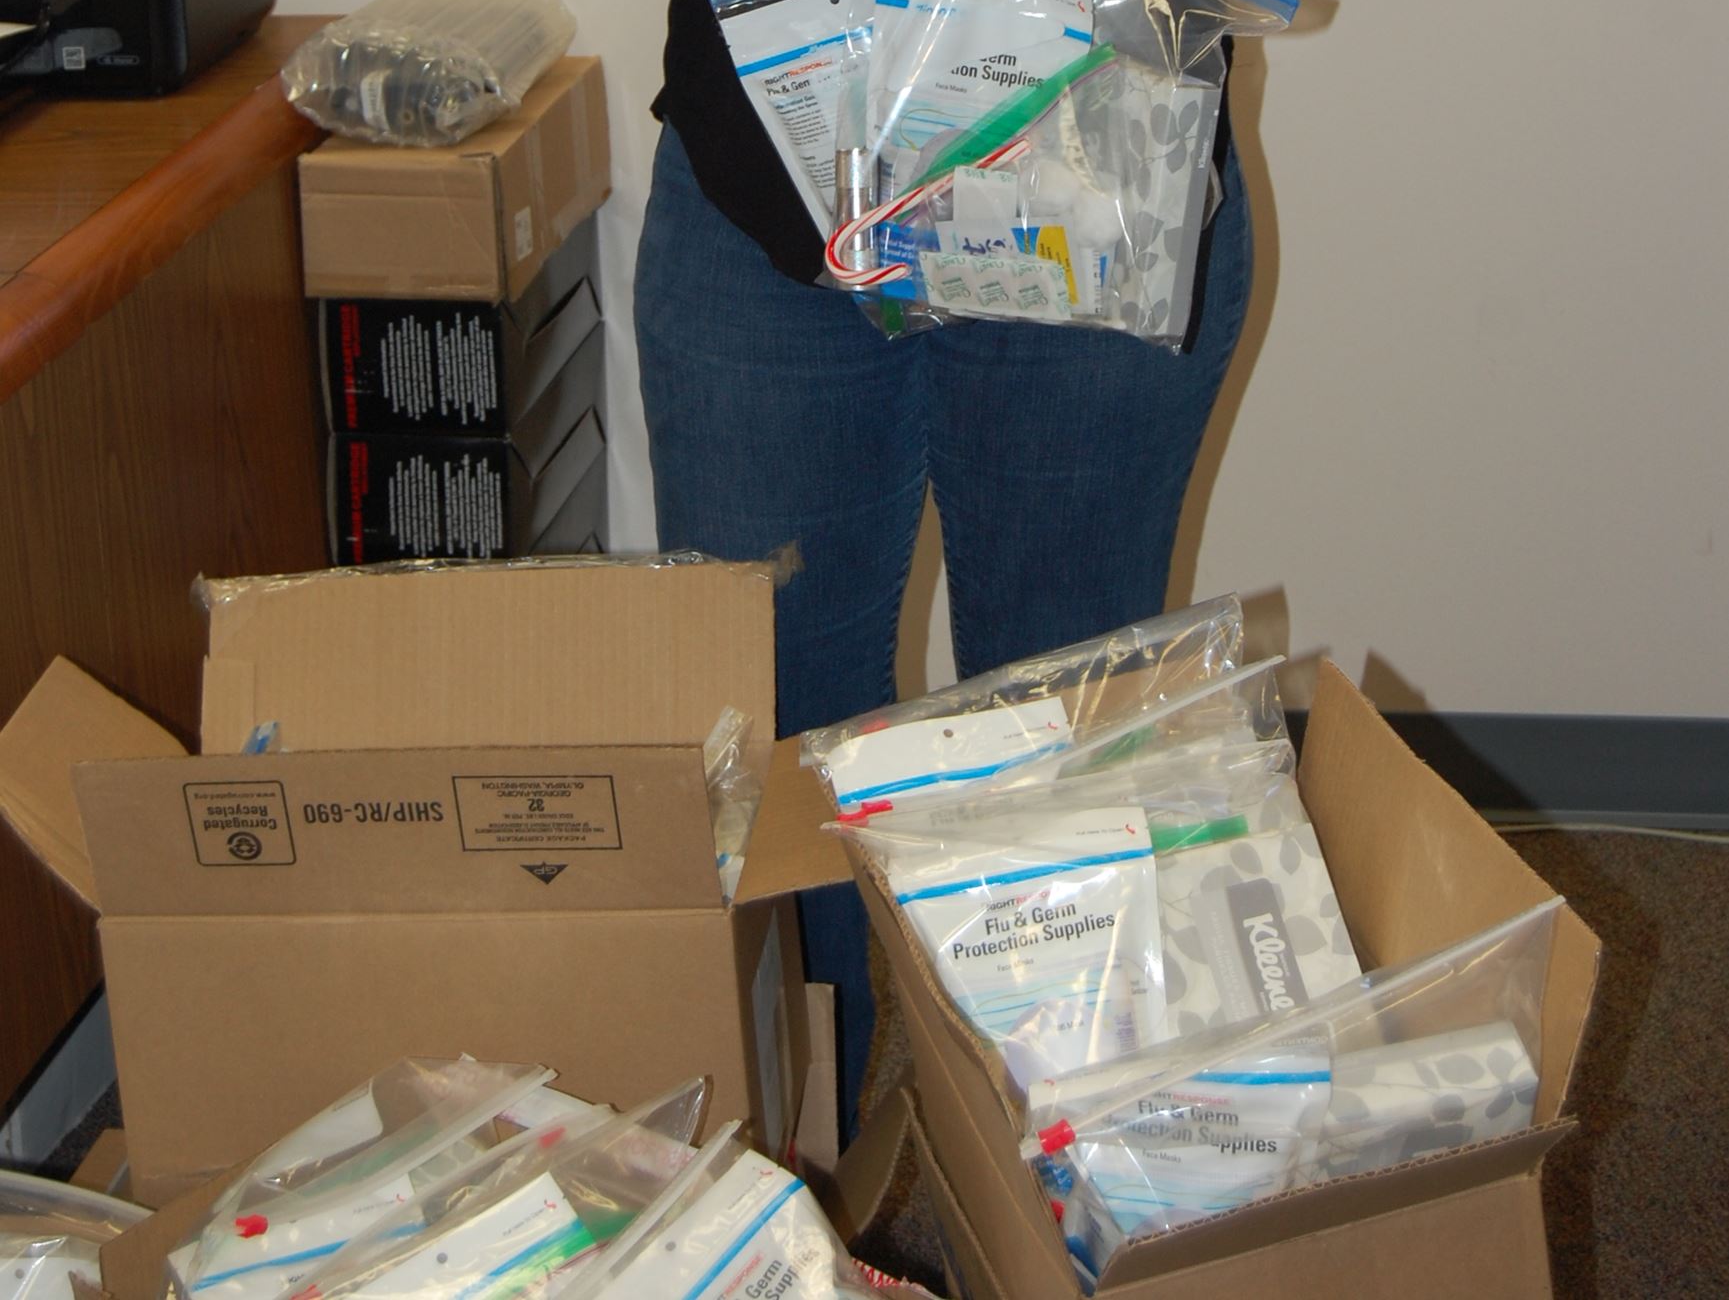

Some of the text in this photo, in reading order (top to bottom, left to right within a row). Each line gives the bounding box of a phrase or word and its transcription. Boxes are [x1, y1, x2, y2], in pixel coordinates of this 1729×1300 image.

[980, 53, 1017, 67] erm
[981, 65, 1045, 88] Supplies
[207, 804, 268, 817] Recycles
[303, 802, 444, 824] SHIP/RC-690
[527, 798, 545, 811] 32
[203, 818, 277, 831] Corrugated
[533, 865, 558, 875] GP
[985, 903, 1077, 936] Flu & Germ
[952, 914, 1116, 960] Protection Supplies
[1243, 913, 1296, 1012] Kleene
[1190, 1106, 1239, 1126] Germ
[1198, 1127, 1277, 1154] Supplies
[745, 1259, 783, 1300] Germ
